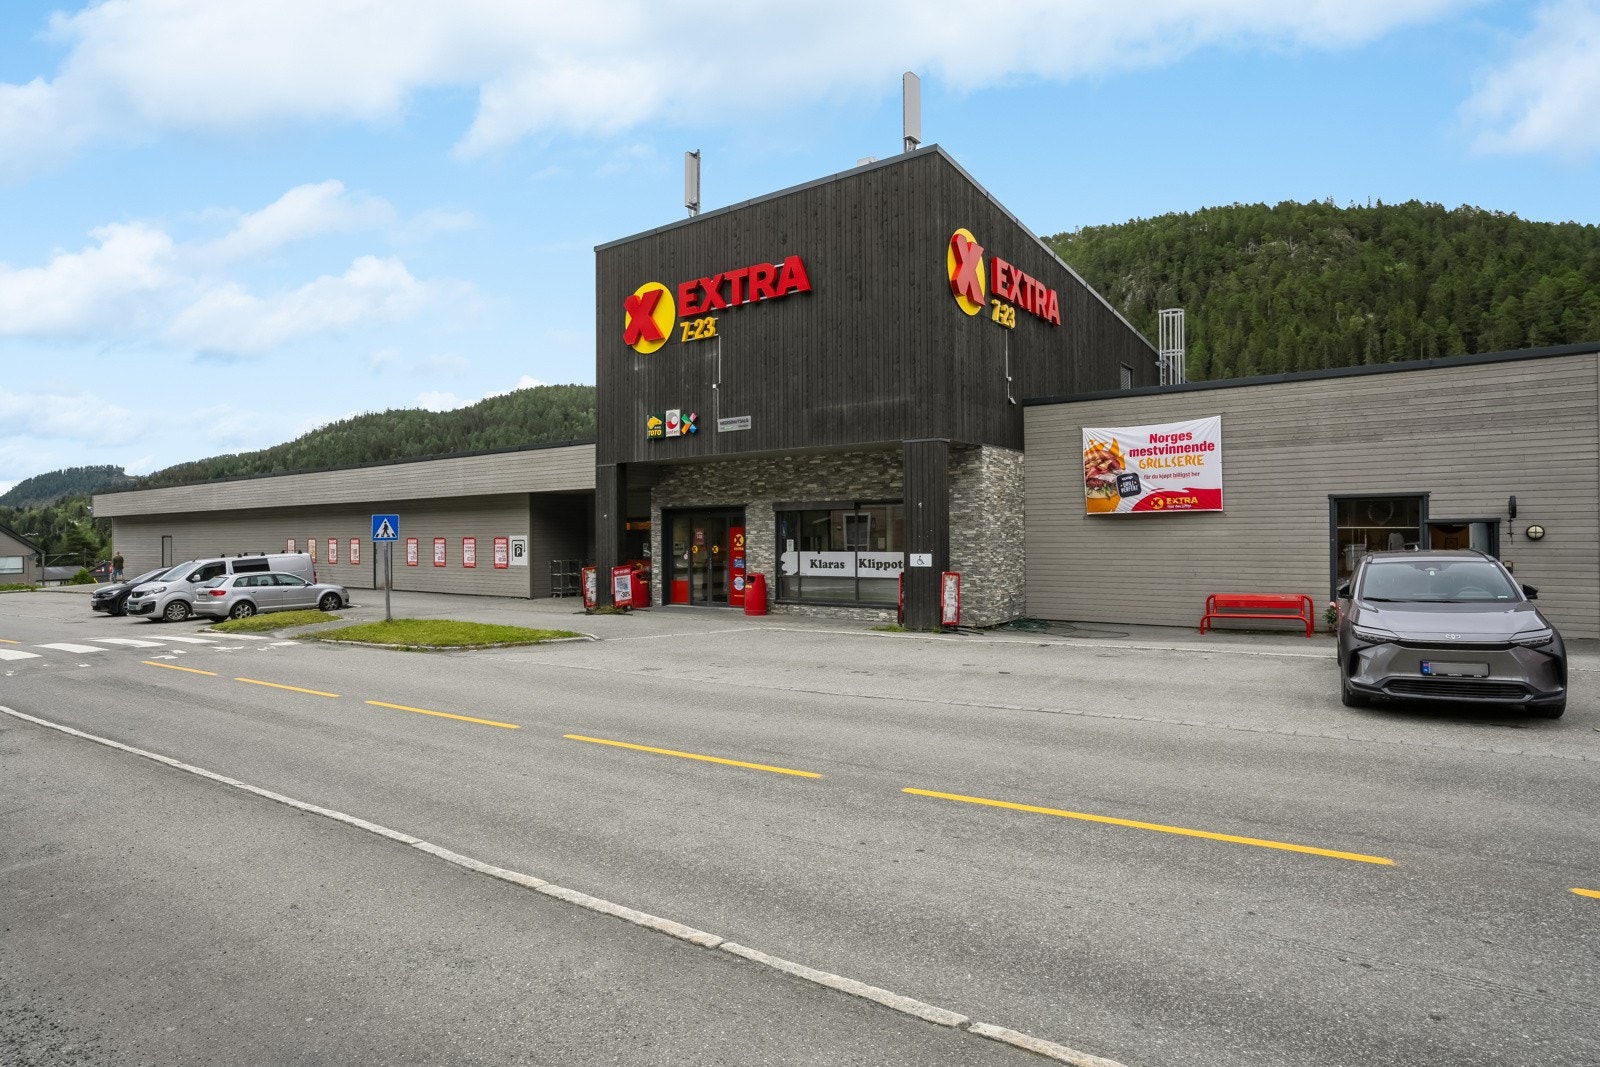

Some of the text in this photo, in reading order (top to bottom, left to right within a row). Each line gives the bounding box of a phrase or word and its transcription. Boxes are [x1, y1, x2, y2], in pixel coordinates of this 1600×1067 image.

[678, 255, 812, 317] EXTRA
[991, 256, 1061, 326] EXTRA
[991, 299, 1016, 330] 7-23
[680, 316, 716, 342] 7-23
[648, 429, 662, 437] TOTO
[1149, 432, 1193, 444] Norges
[1129, 441, 1215, 457] mestvinnende
[1139, 454, 1205, 470] GRILLSERIE
[1166, 496, 1198, 505] EXTRA
[809, 558, 845, 570] Klaras
